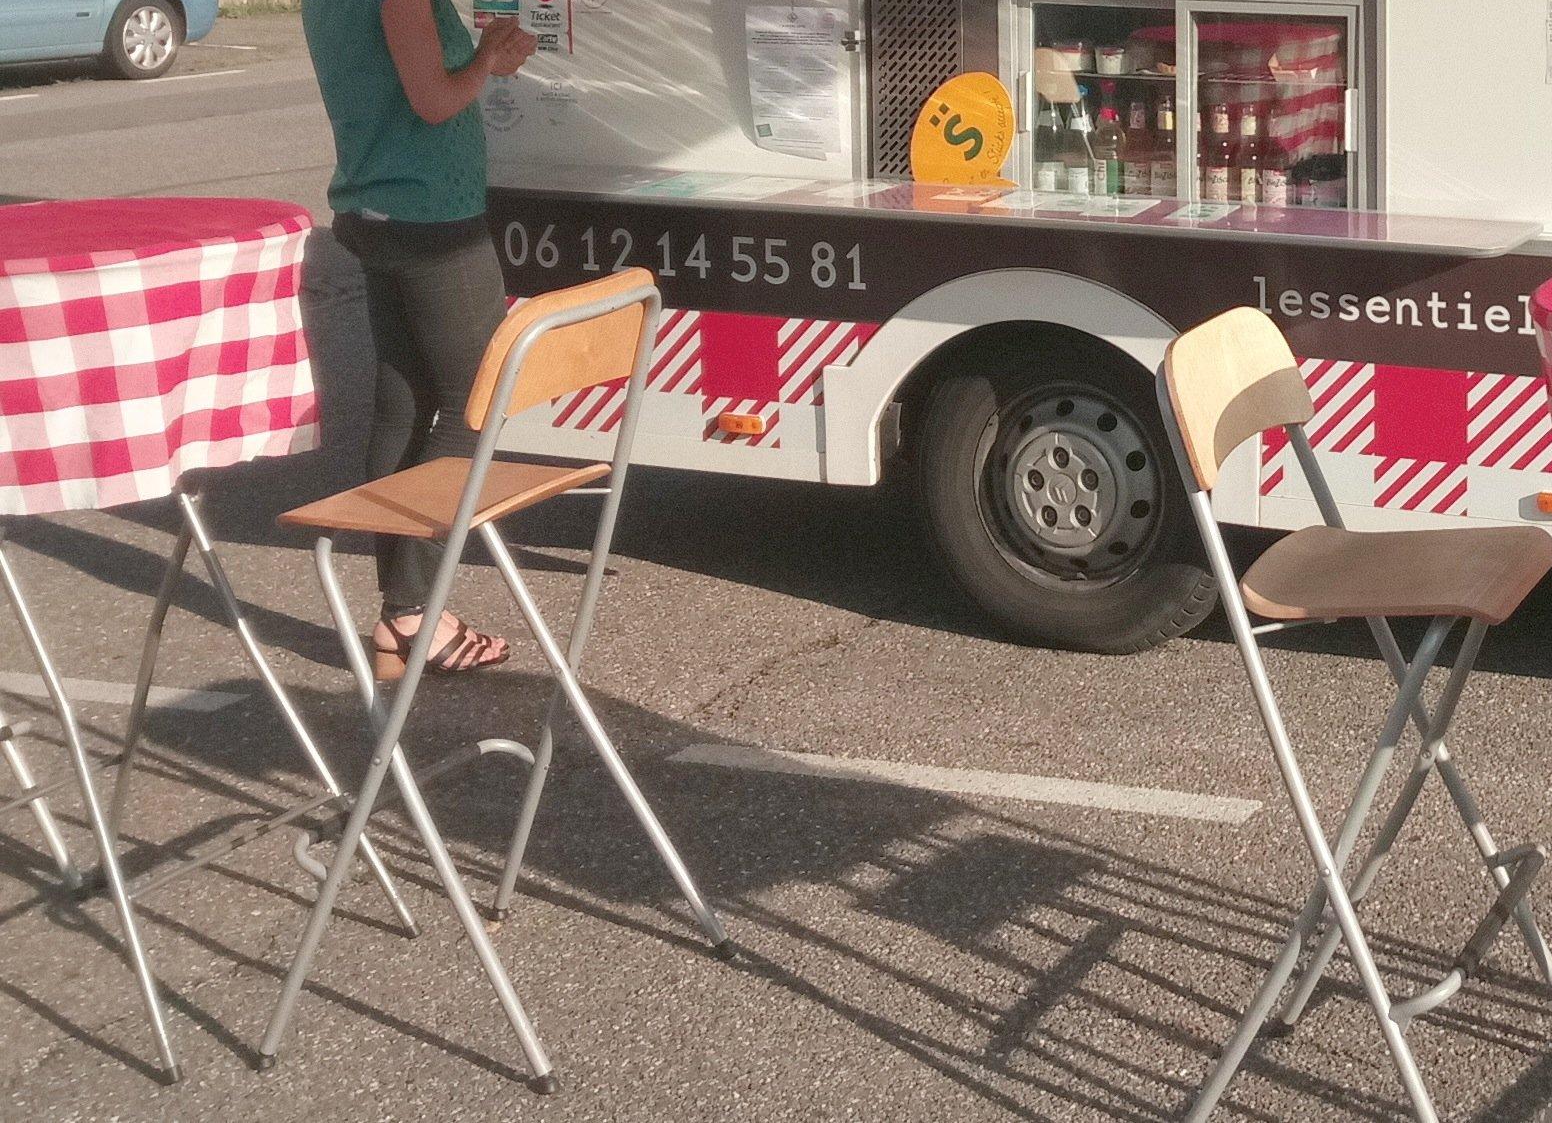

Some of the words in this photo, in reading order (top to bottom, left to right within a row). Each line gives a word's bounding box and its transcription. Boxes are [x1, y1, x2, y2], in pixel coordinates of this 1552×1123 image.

[530, 10, 561, 22] Ticket
[504, 221, 560, 269] 06
[580, 226, 634, 273] 12
[656, 231, 711, 278] 14
[730, 236, 790, 285] 55
[810, 241, 867, 291] 81
